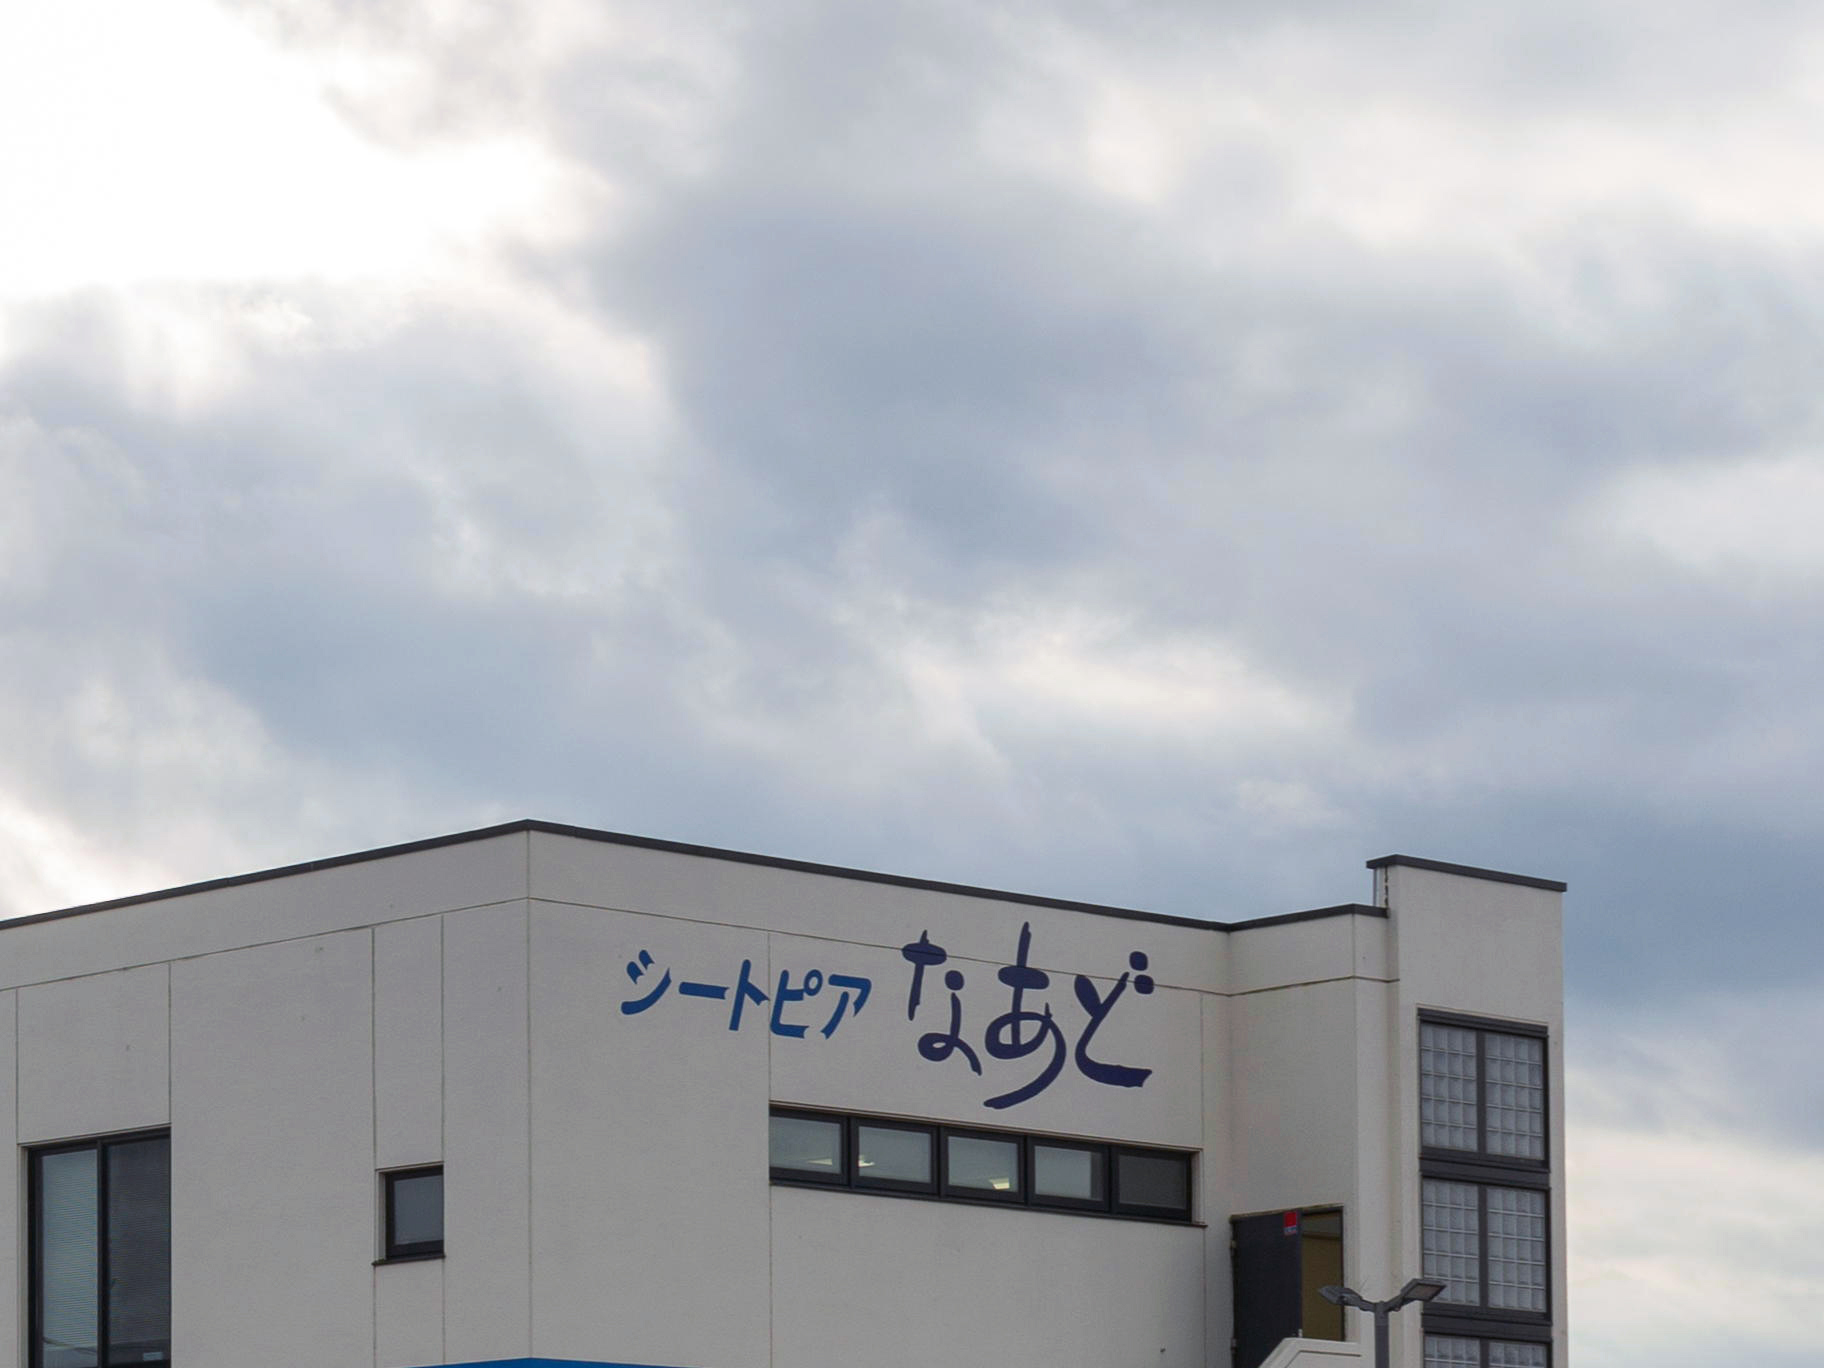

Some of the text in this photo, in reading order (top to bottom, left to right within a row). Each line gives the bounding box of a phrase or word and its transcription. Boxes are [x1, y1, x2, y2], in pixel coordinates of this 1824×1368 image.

[620, 921, 1155, 1110] シートピア なあど
